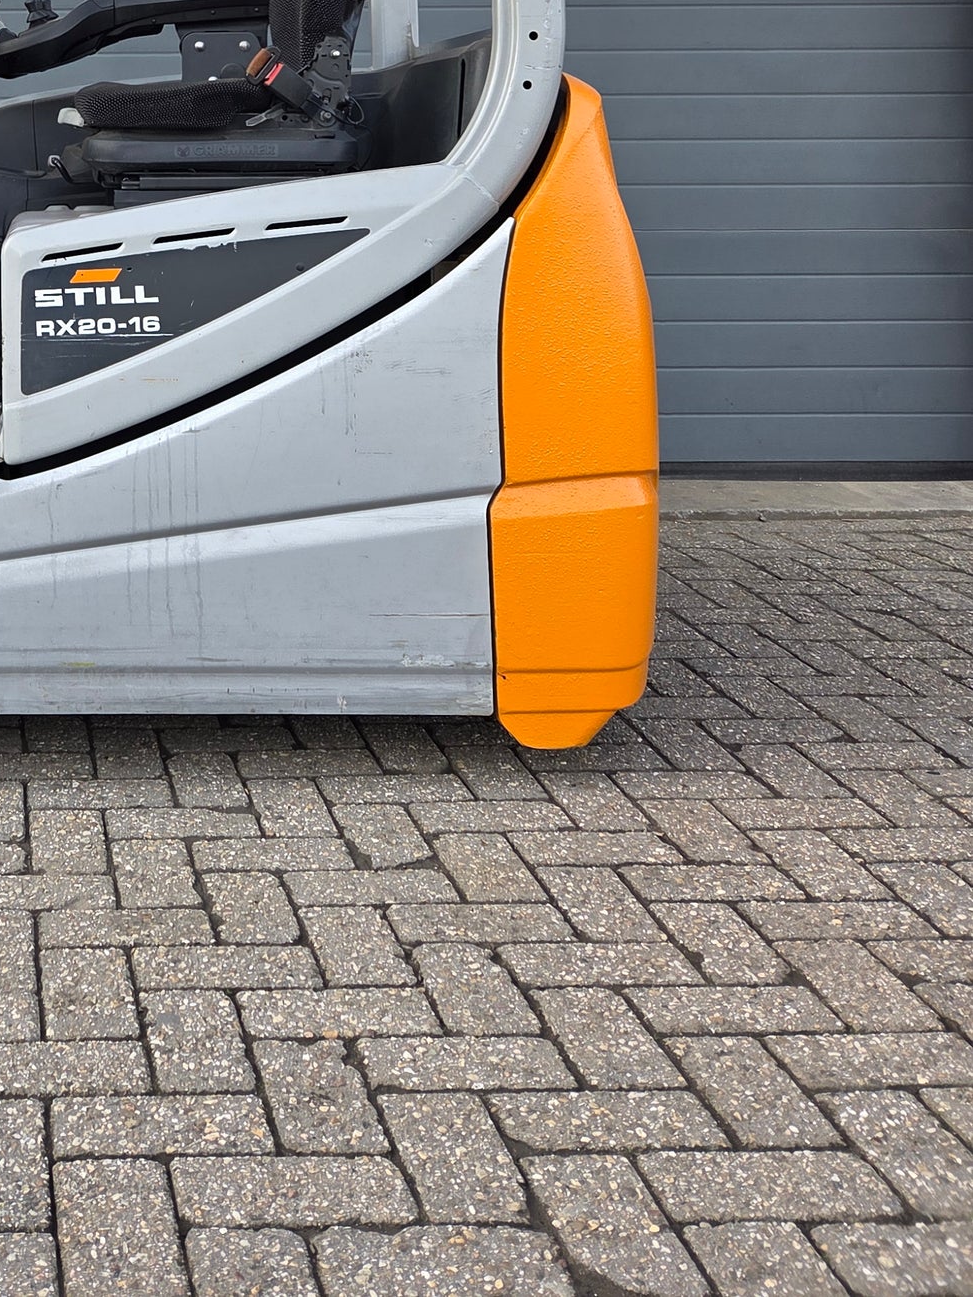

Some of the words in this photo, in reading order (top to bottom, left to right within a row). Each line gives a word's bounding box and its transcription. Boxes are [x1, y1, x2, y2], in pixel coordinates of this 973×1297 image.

[193, 144, 276, 157] GRAMMER
[34, 285, 160, 308] STILL
[35, 315, 161, 337] RX20-16
